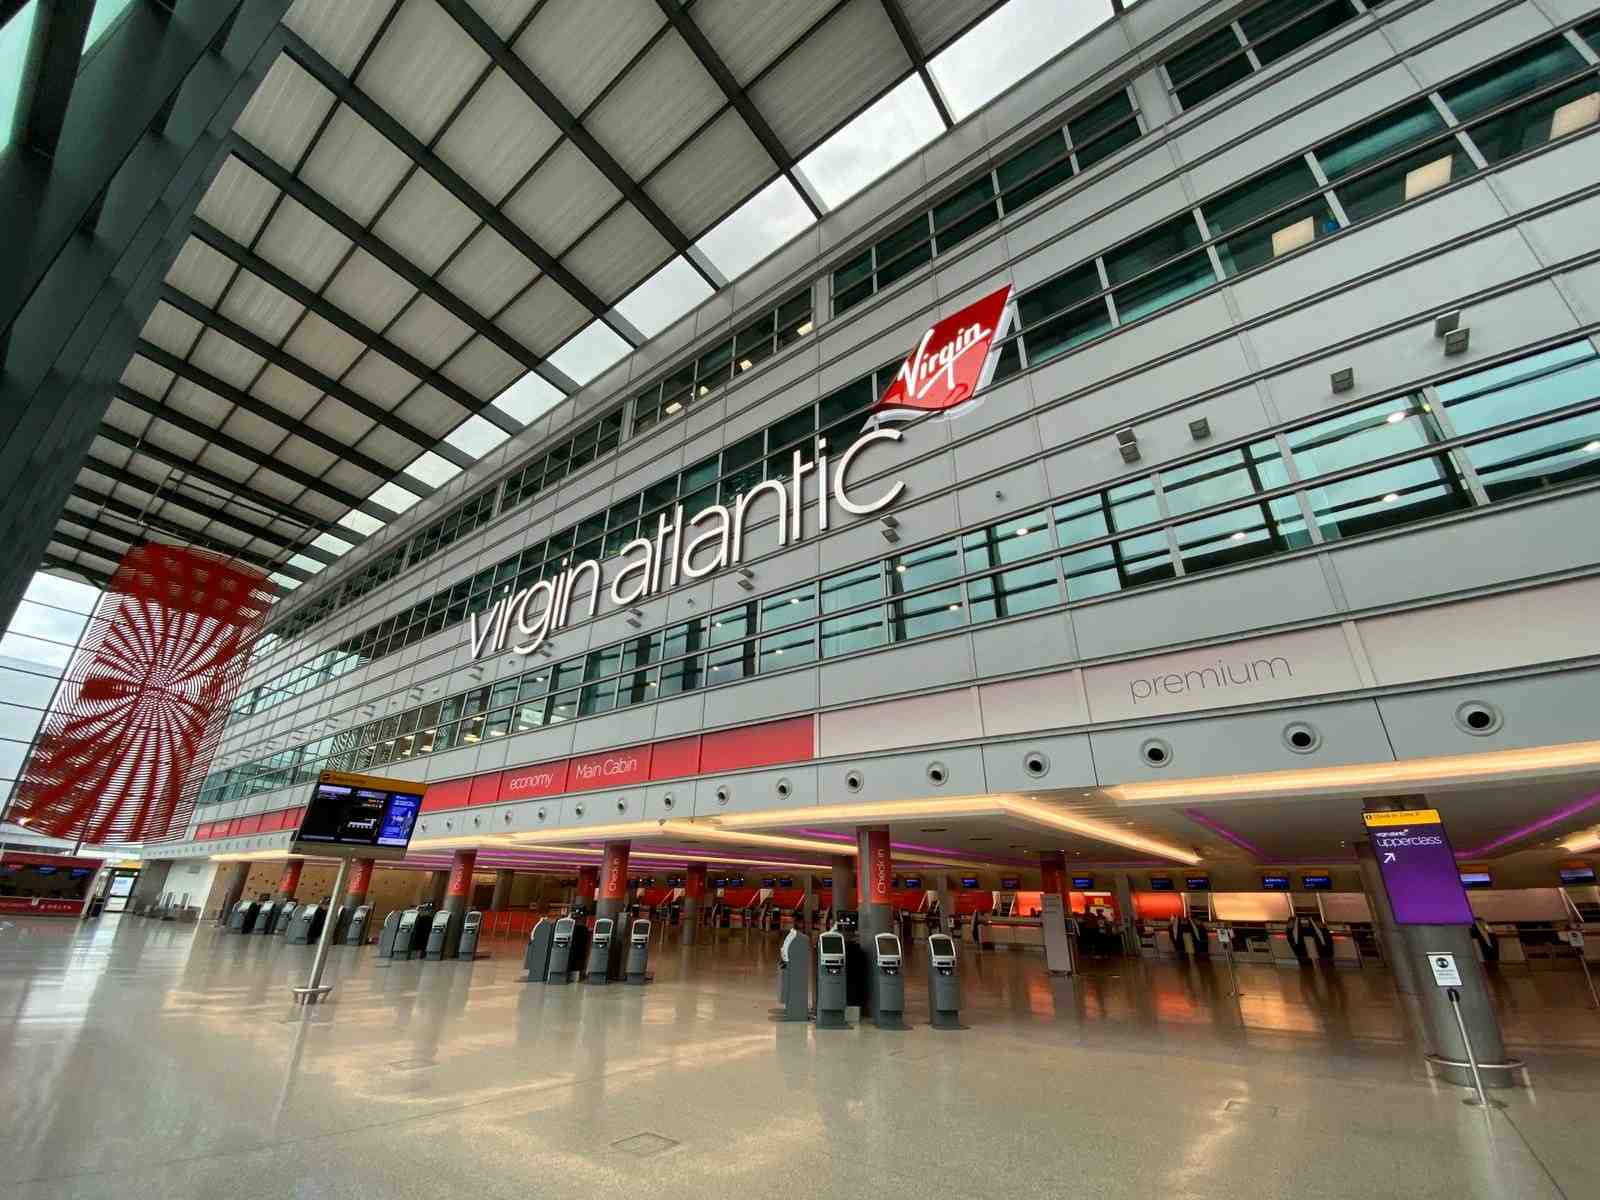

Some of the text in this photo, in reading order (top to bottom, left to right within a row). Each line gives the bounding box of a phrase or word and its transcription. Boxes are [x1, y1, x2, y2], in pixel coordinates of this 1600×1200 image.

[896, 323, 992, 399] Virgin
[470, 428, 906, 656] virgin atlantic
[1129, 656, 1293, 705] premium
[509, 772, 553, 789] economy
[575, 756, 637, 780] Main Cabin
[1376, 836, 1442, 848] upperclass
